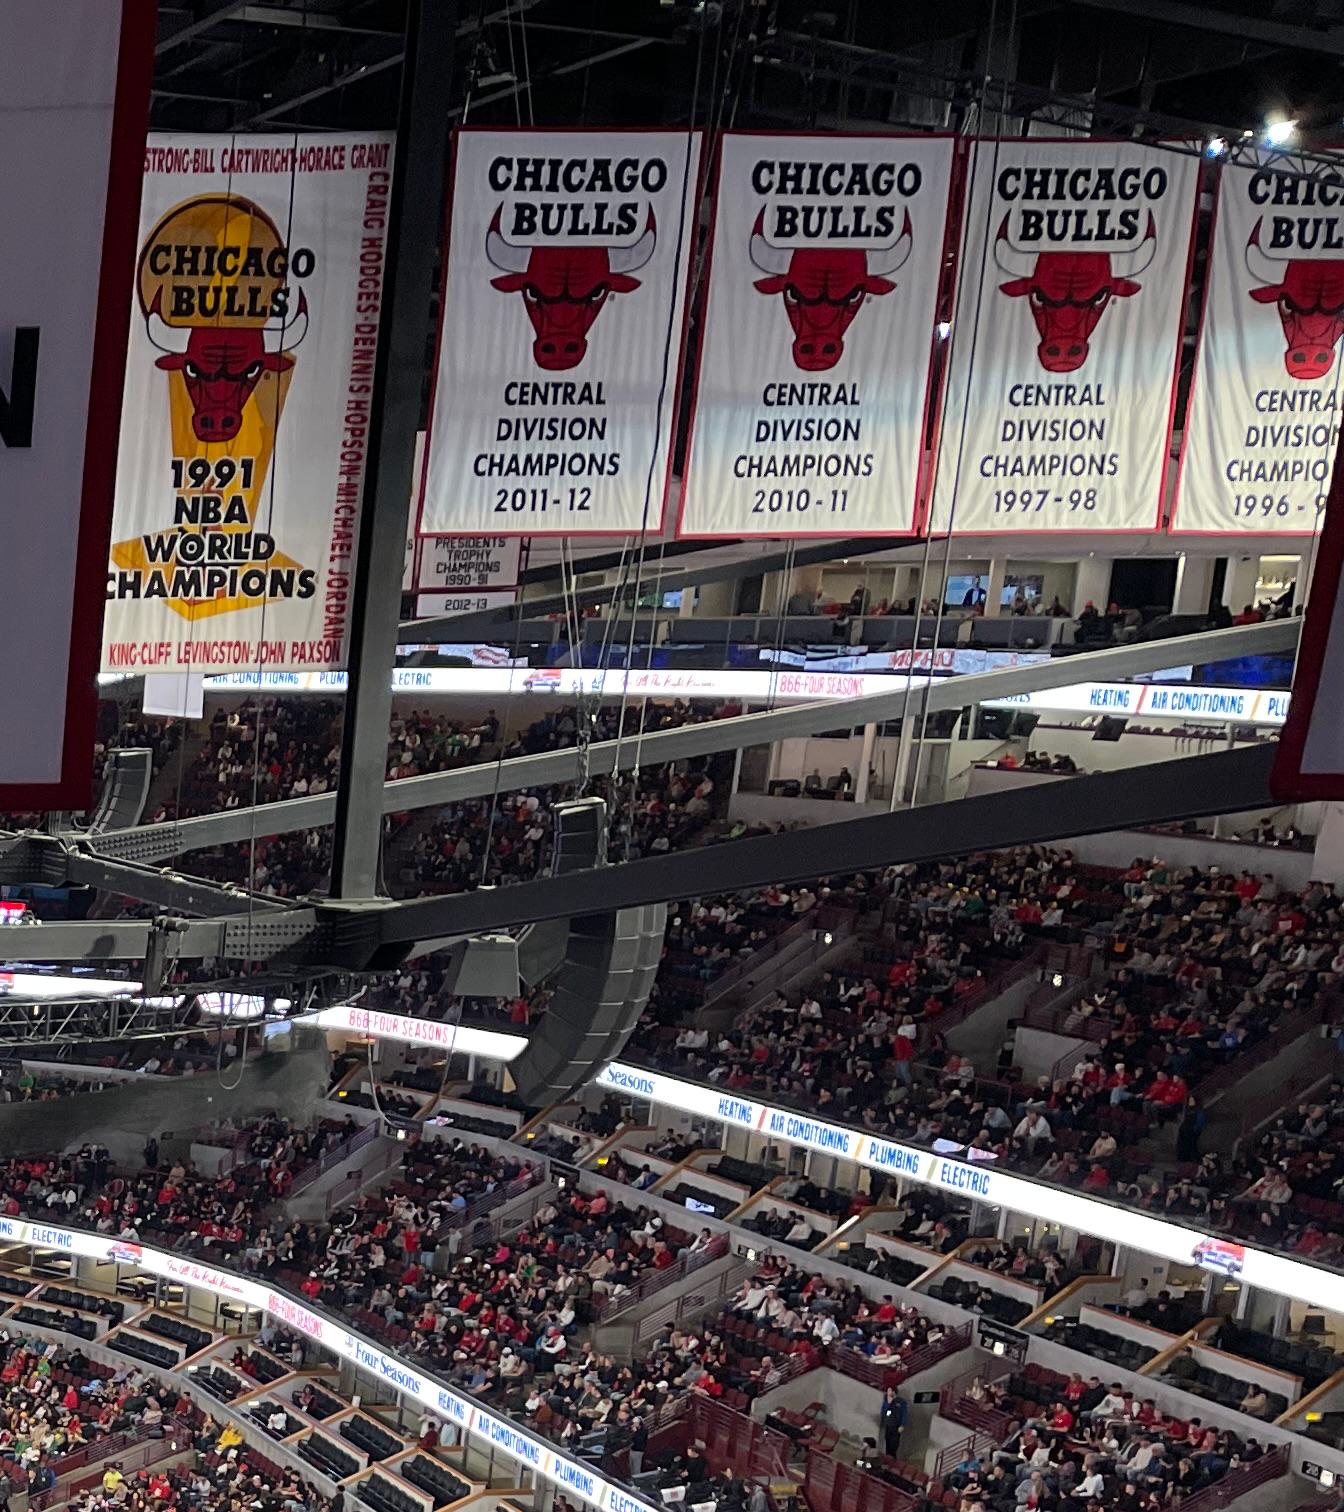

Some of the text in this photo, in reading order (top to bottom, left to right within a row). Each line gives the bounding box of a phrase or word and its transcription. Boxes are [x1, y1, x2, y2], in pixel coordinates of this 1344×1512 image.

[489, 157, 667, 192] CHICAGO
[752, 160, 922, 197] CHICAGO
[997, 166, 1167, 201] CHICAGO
[511, 202, 639, 236] BULLS
[774, 205, 895, 239] BULLS
[1019, 208, 1140, 242] BULLS
[149, 245, 315, 278] CHICAGO
[171, 286, 290, 318] BULLS
[504, 382, 606, 406] CENTRAL
[763, 383, 860, 407] CENTRAL
[1009, 383, 1105, 407] CENTRAL
[1255, 390, 1344, 413] CENTRA
[496, 417, 607, 442] DIVISION
[755, 418, 861, 443] DIVISION
[1001, 418, 1105, 442] DIVISION
[171, 459, 253, 489] 1991
[473, 453, 620, 477] CHAMPIONS
[733, 454, 874, 478] CHAMPIONS
[980, 454, 1119, 478] CHAMPIONS
[174, 495, 249, 525] NBA
[144, 533, 276, 563] WORLD
[435, 538, 506, 549] PRESIDENTS
[447, 550, 491, 561] TROPHY
[436, 561, 500, 573] CHAMPIONS
[444, 598, 487, 611] 2012-13
[719, 1098, 990, 1195] HEATING AIR CONDITIONING PLUMBING ELECTRIC
[32, 1228, 72, 1248] ELECTRIC
[491, 1422, 540, 1465] CONDITIONING
[554, 1460, 593, 1496] PLUMBING
